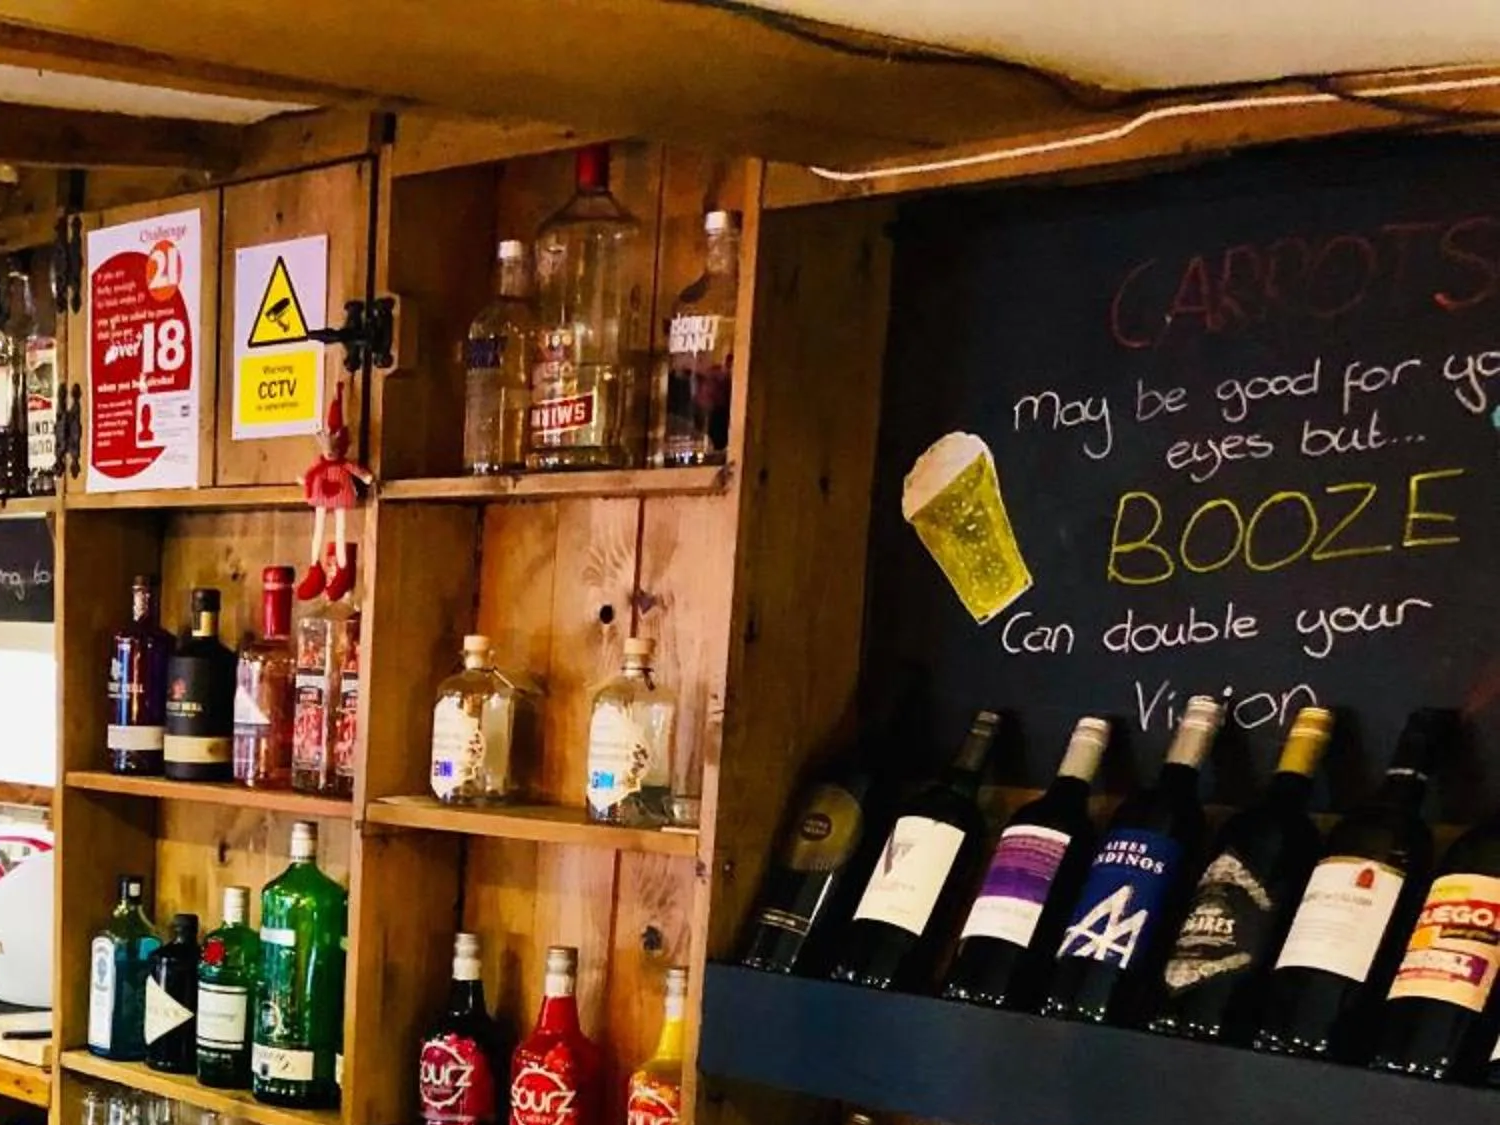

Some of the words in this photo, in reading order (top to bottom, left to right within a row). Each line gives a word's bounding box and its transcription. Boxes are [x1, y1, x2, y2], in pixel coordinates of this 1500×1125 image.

[148, 248, 179, 288] 21
[142, 318, 186, 372] 18
[257, 377, 297, 400] CCTV
[1135, 379, 1187, 421] be
[1216, 357, 1321, 423] good
[1341, 356, 1422, 416] for
[1442, 350, 1500, 414] yo
[1166, 431, 1274, 482] eyes
[1106, 467, 1465, 587] BOOZE
[1001, 611, 1074, 655] Can
[1103, 602, 1259, 653] double
[1296, 599, 1434, 658] your
